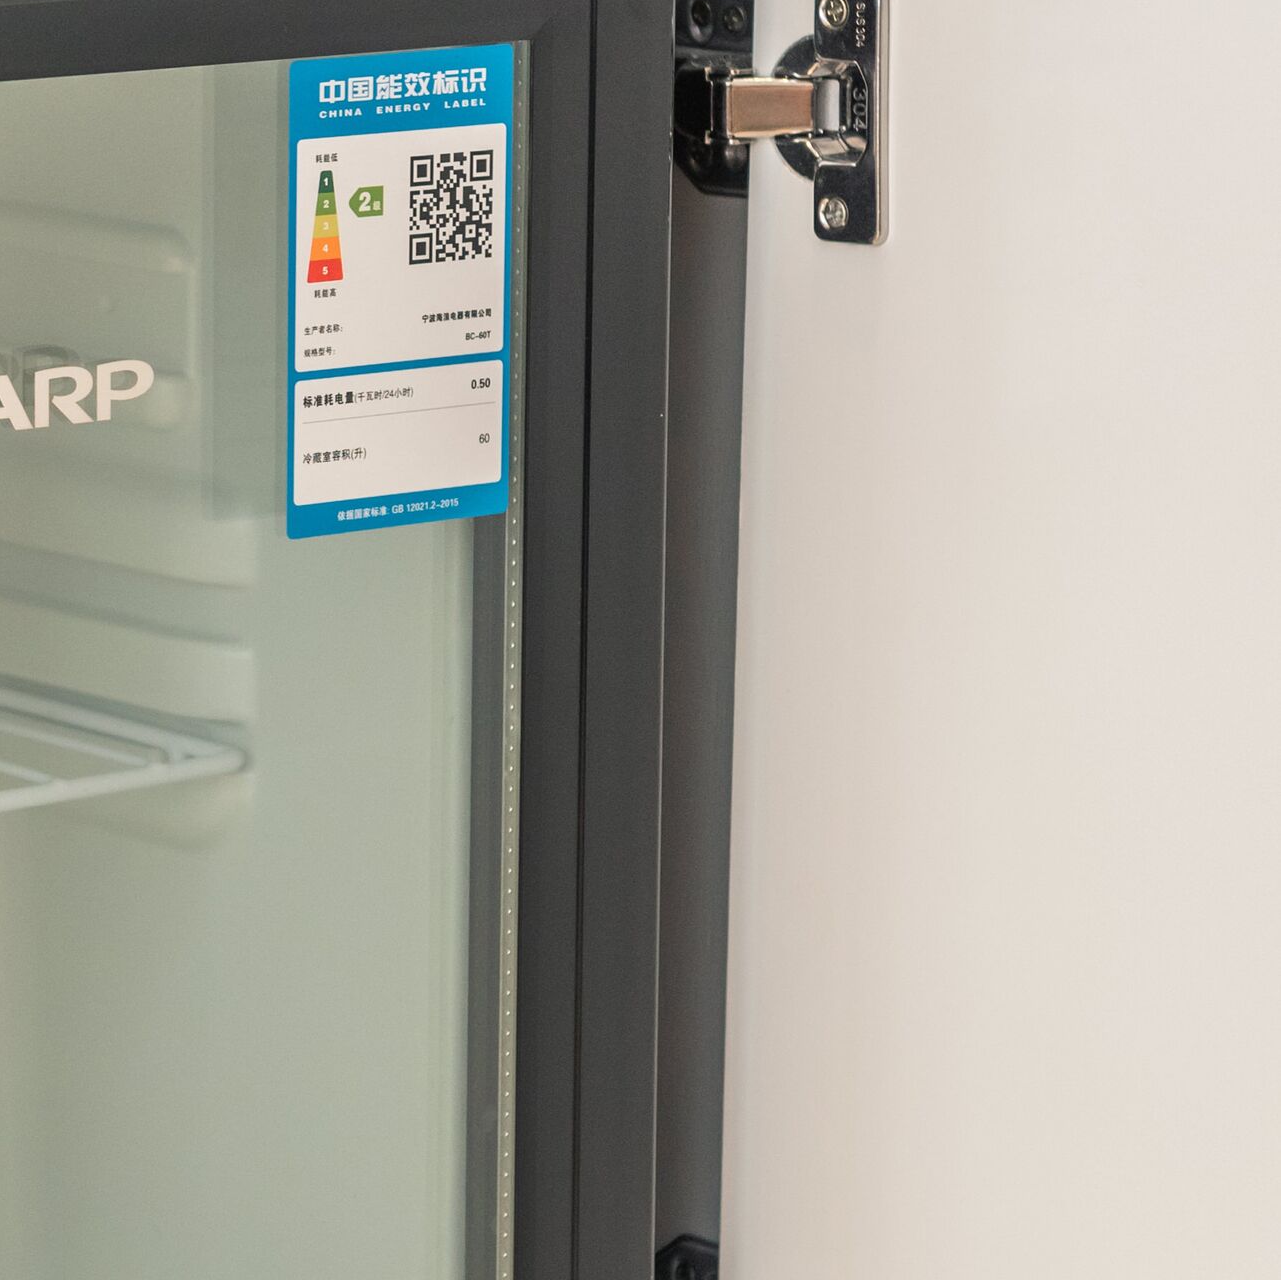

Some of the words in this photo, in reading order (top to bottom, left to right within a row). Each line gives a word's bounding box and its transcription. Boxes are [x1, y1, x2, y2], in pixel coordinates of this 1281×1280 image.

[319, 67, 487, 104] 中国能效标识
[319, 108, 363, 119] CHINA
[376, 102, 431, 115] ENERGY
[444, 97, 486, 109] LABEL
[323, 177, 329, 187] 1
[323, 200, 329, 209] 2
[323, 222, 329, 231] 3
[322, 244, 329, 253] 4
[322, 266, 328, 275] 5
[471, 377, 491, 389] 0.50
[479, 433, 490, 444] 60
[391, 504, 404, 514] GB
